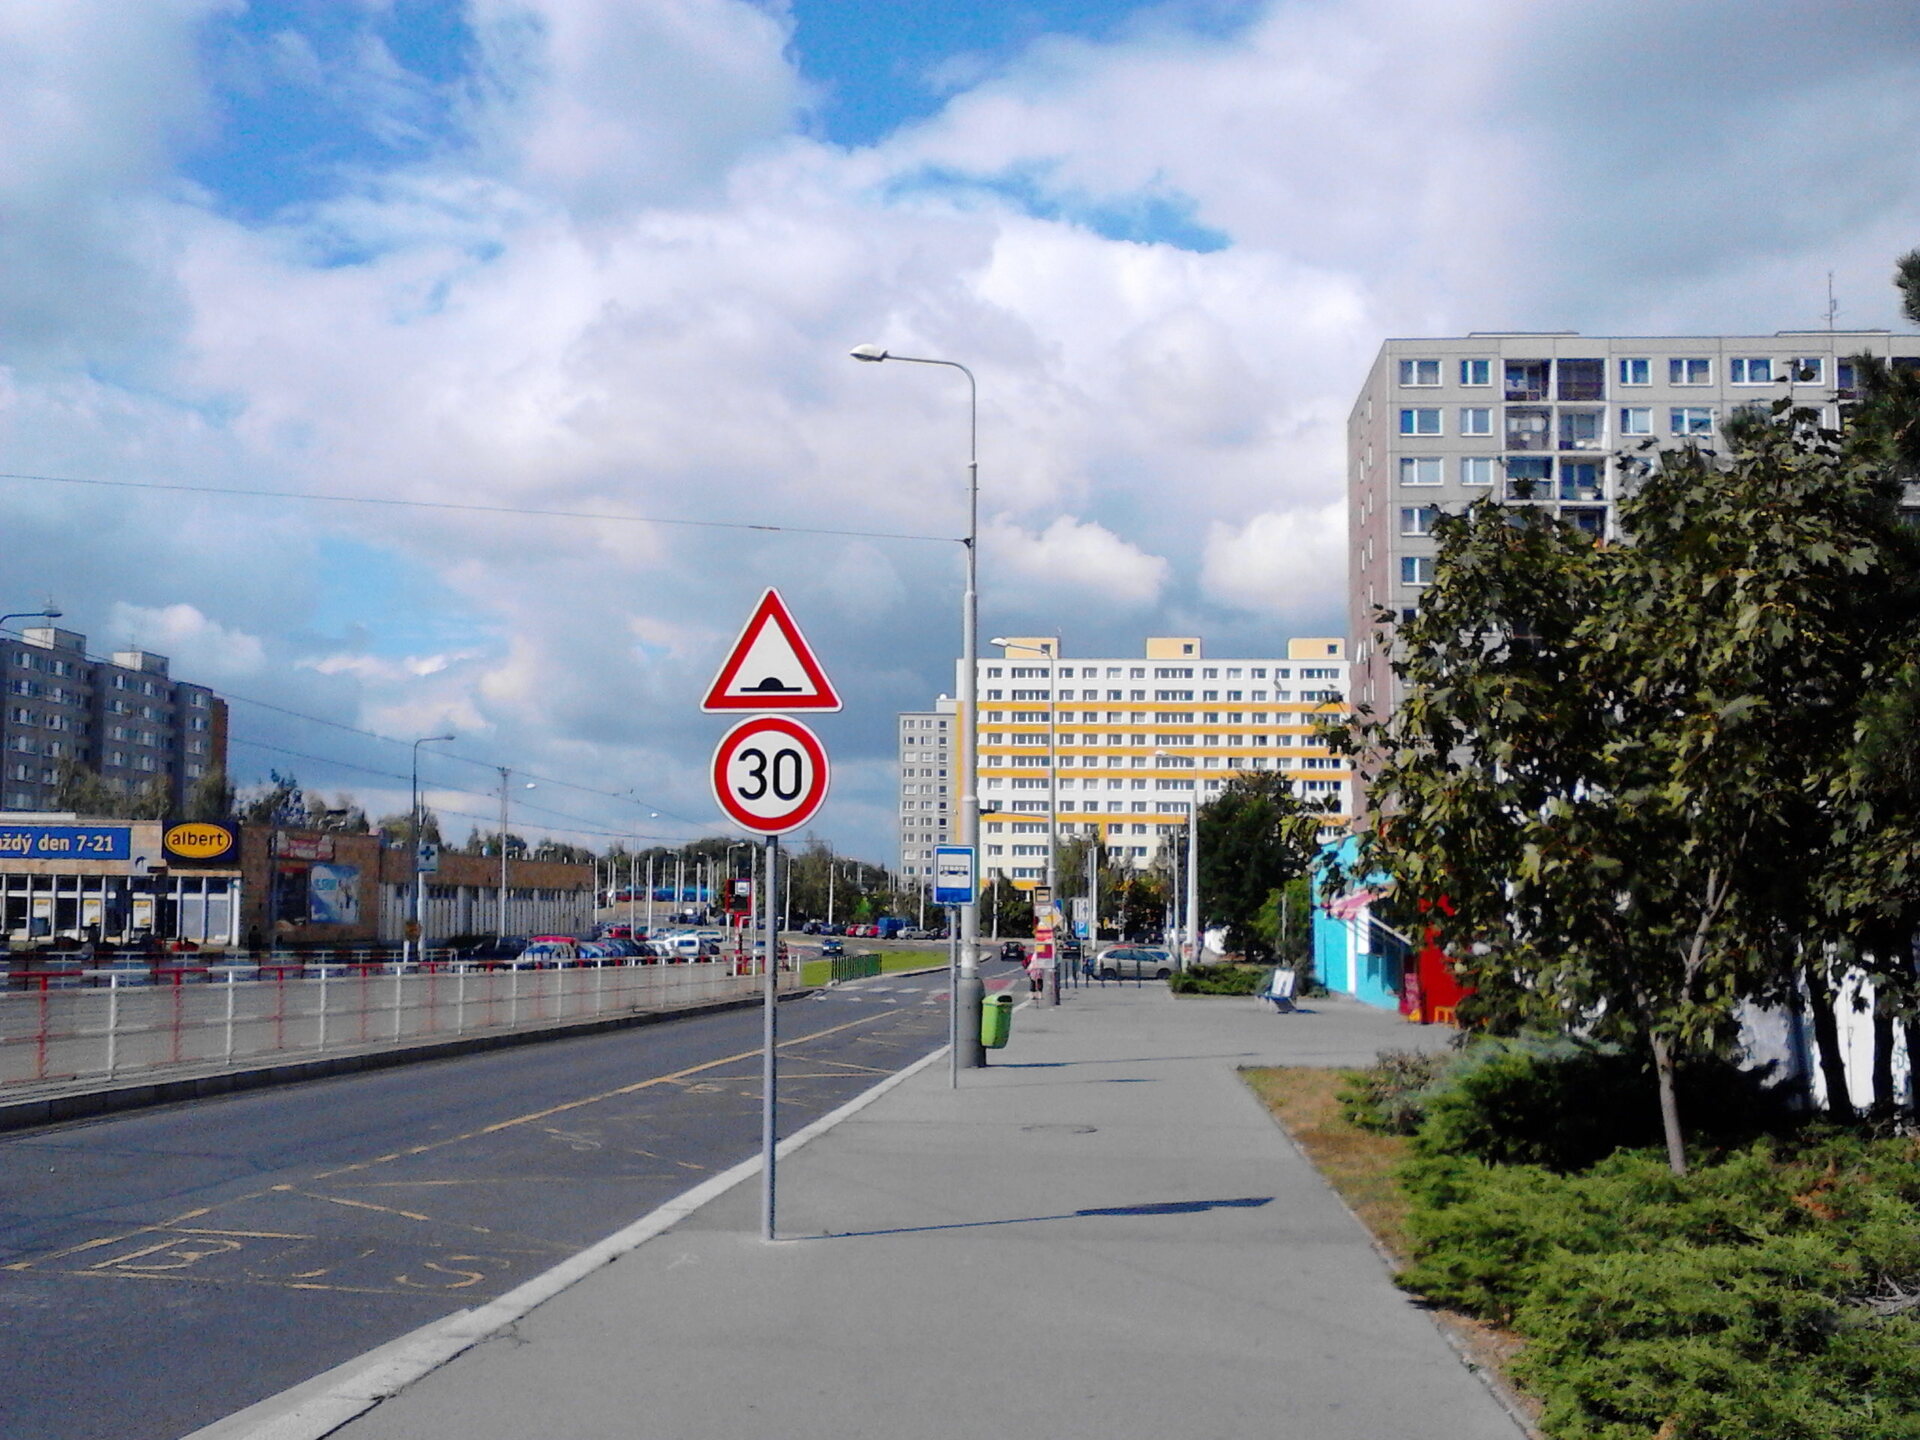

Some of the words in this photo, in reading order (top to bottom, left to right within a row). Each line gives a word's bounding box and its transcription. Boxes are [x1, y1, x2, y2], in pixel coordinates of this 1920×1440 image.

[738, 748, 802, 800] 30
[38, 834, 70, 851] den
[77, 835, 113, 852] 7-21
[171, 832, 224, 847] albert
